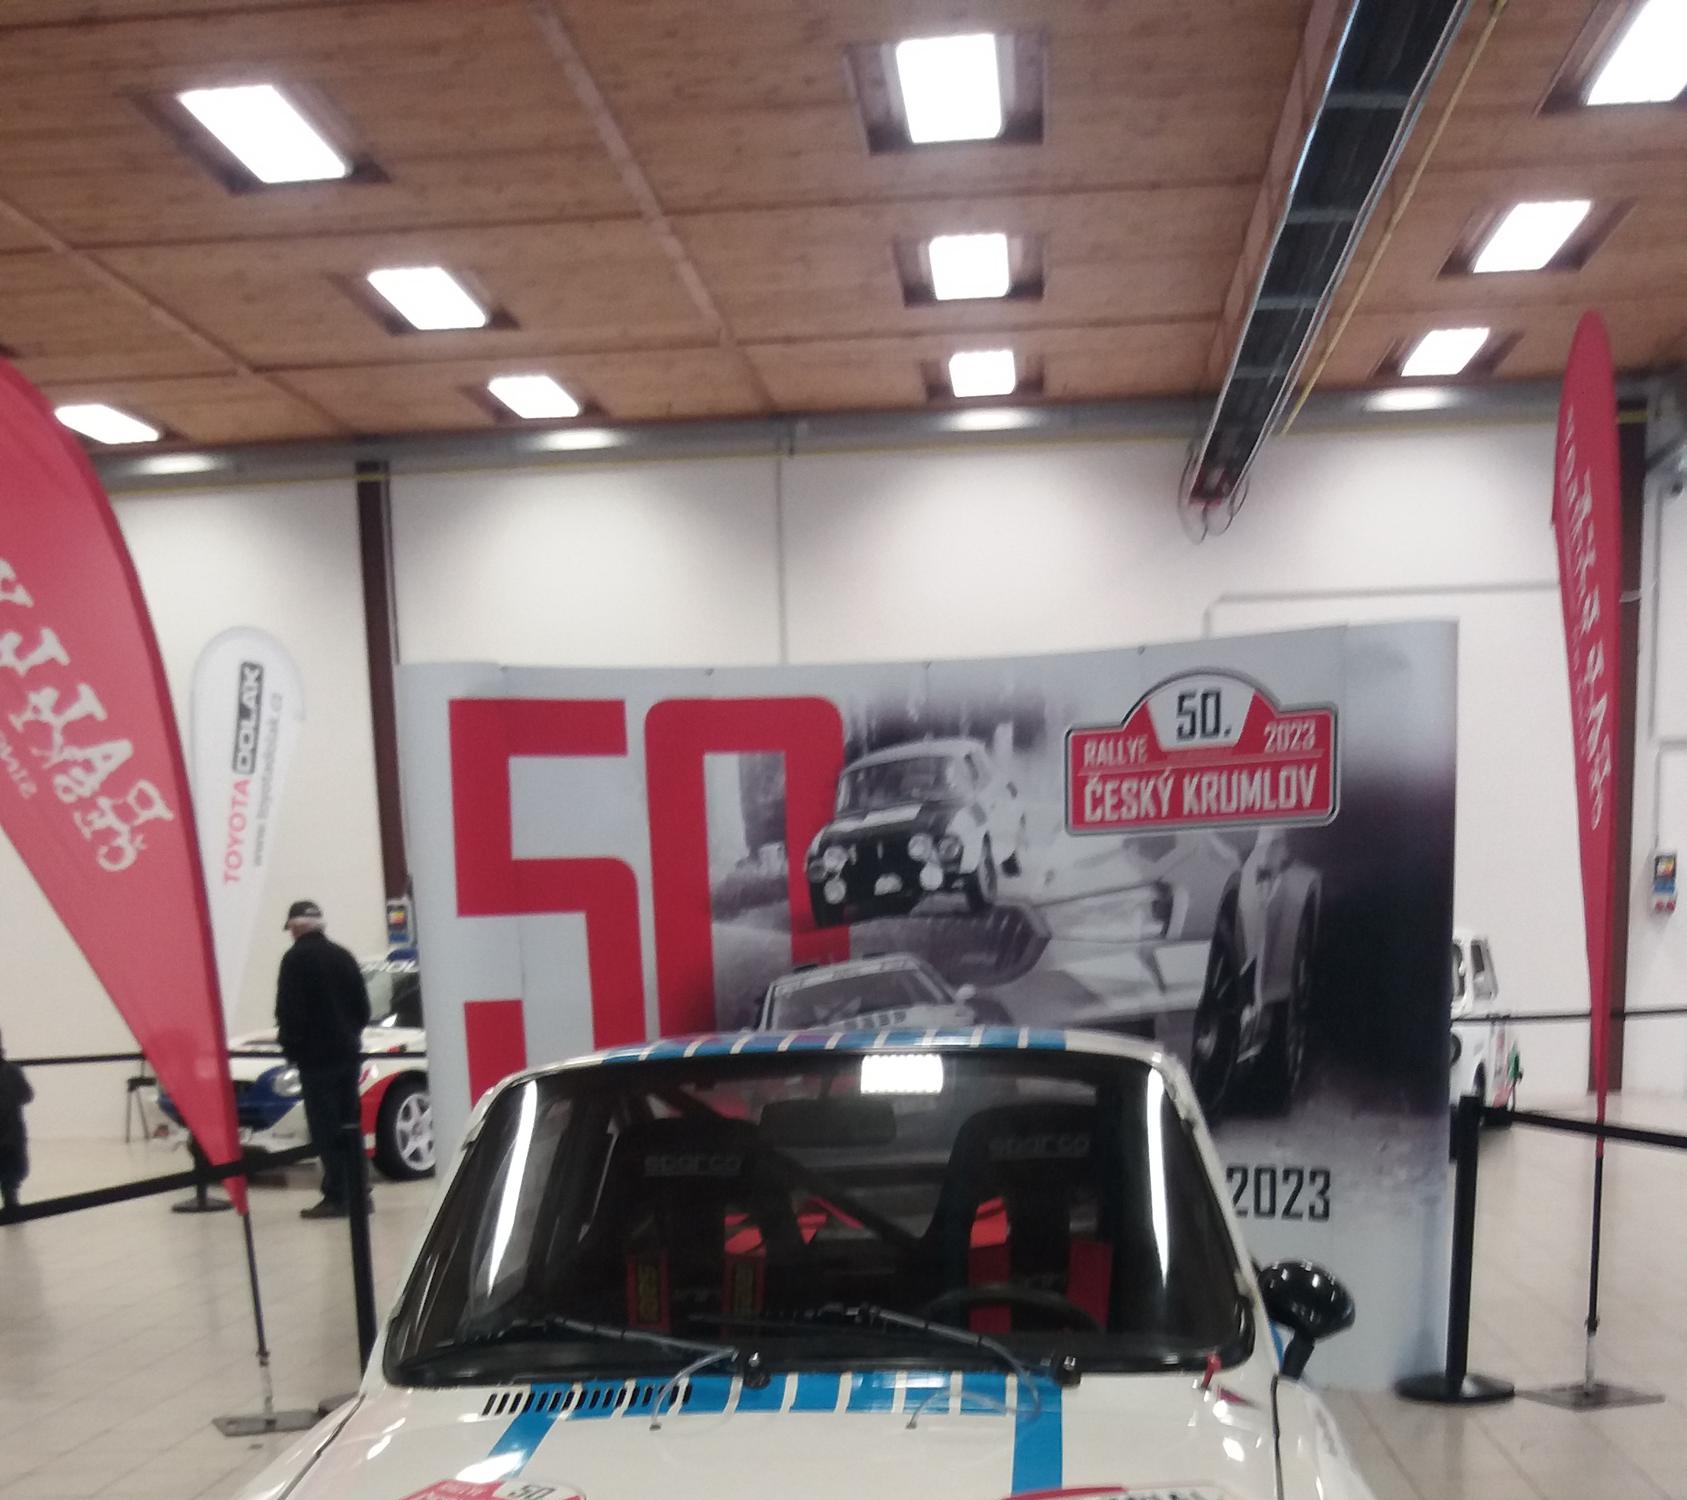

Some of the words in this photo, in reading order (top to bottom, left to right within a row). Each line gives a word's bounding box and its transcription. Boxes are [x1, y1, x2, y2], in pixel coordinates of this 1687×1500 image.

[234, 664, 262, 773] DOLAK
[1083, 734, 1148, 767] RALLYE
[1264, 719, 1316, 752] 2023
[1176, 687, 1232, 742] 50.
[1084, 768, 1176, 823] ČESKÝ
[1182, 764, 1318, 816] KRUMLOV
[223, 779, 251, 885] TOYOTA
[449, 696, 849, 1110] 50
[1226, 1164, 1330, 1221] 2023
